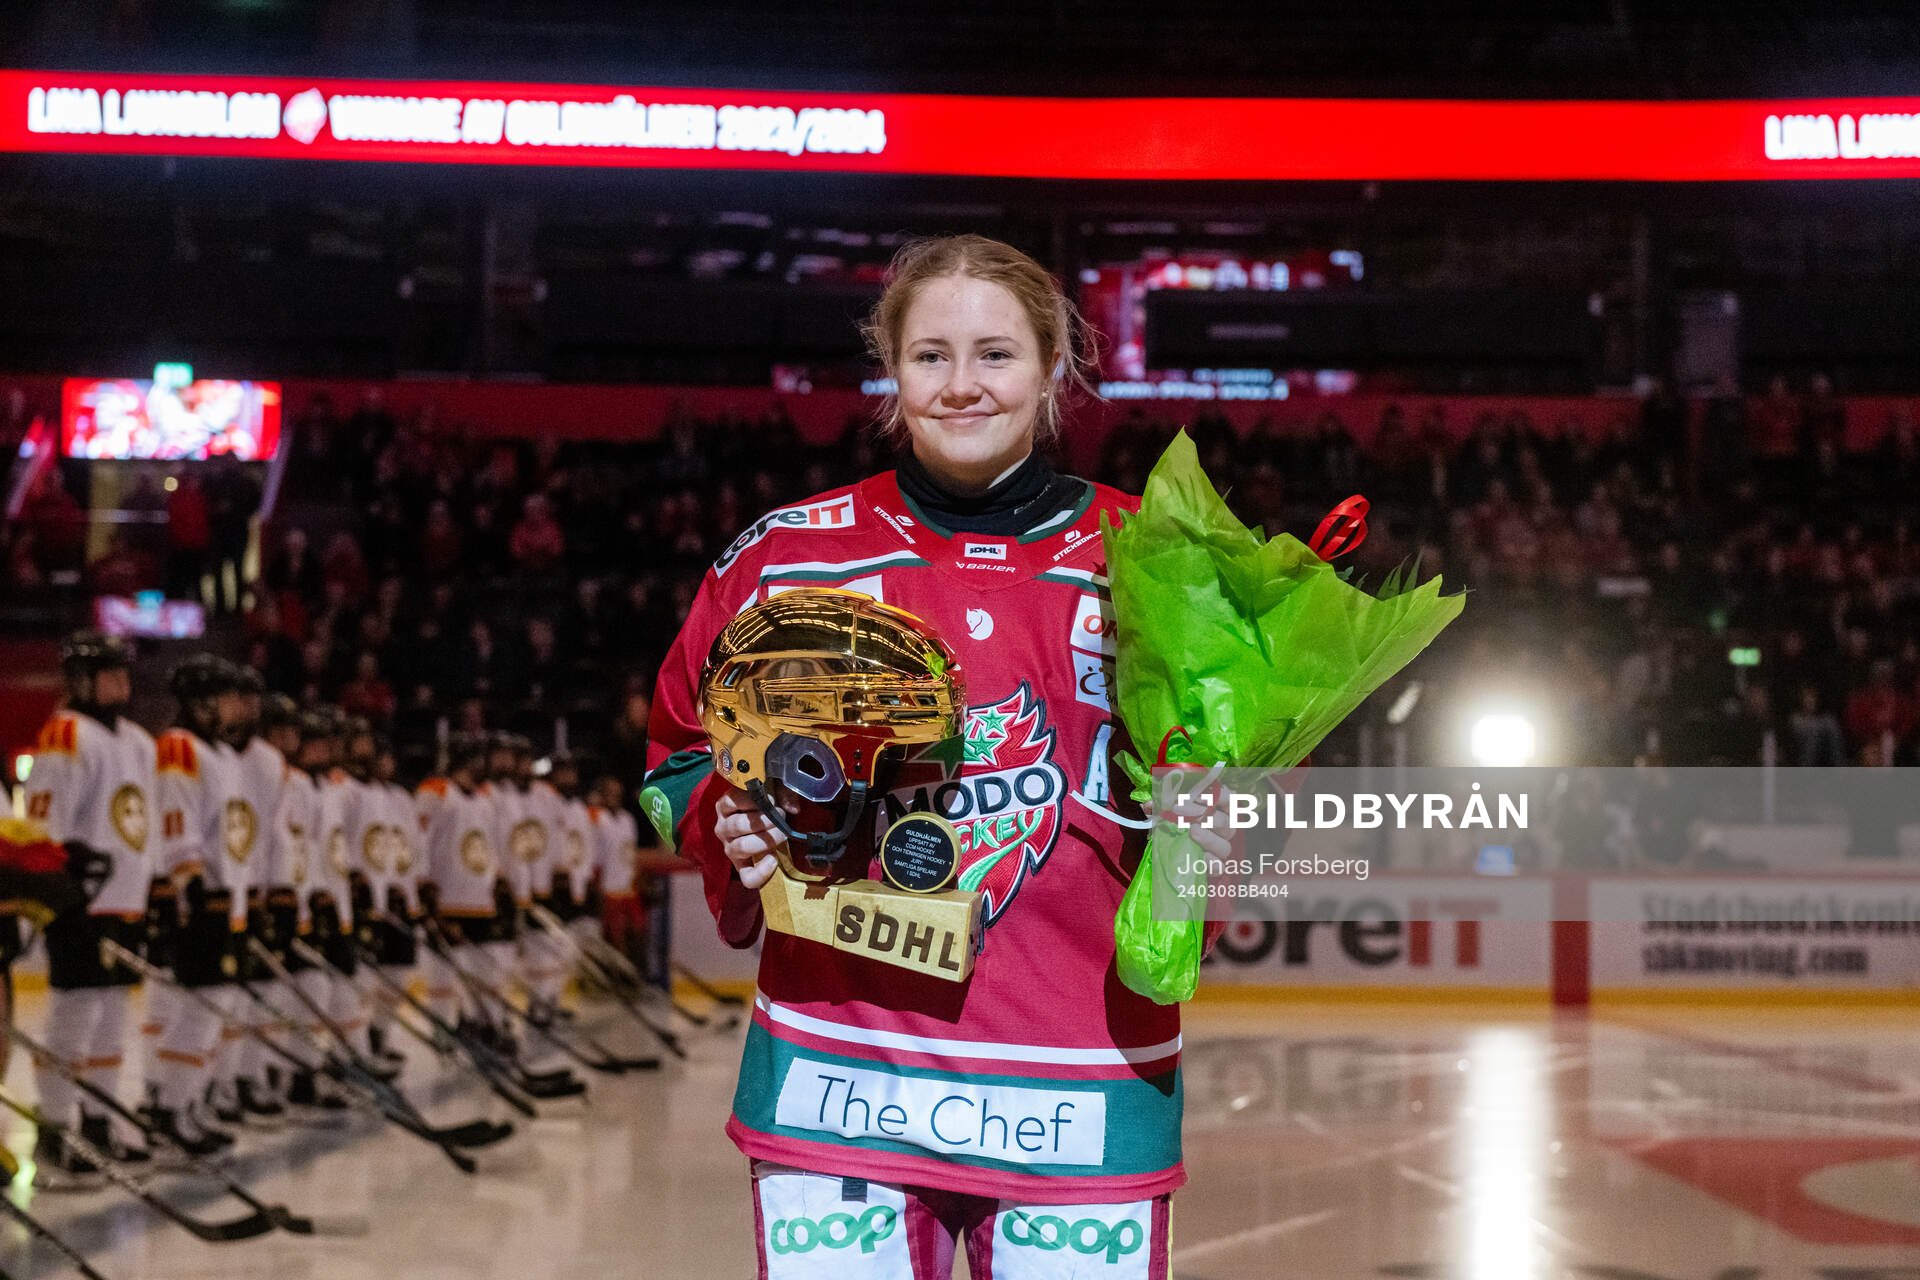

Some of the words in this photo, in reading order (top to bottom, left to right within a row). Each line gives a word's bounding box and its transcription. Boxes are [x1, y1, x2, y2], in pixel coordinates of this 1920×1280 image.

[835, 904, 960, 972] SDHL
[1201, 896, 1500, 968] oreIT
[817, 1074, 908, 1136] The
[930, 1094, 1076, 1153] Chef
[770, 1205, 896, 1256] coop
[1002, 1209, 1144, 1264] coop
